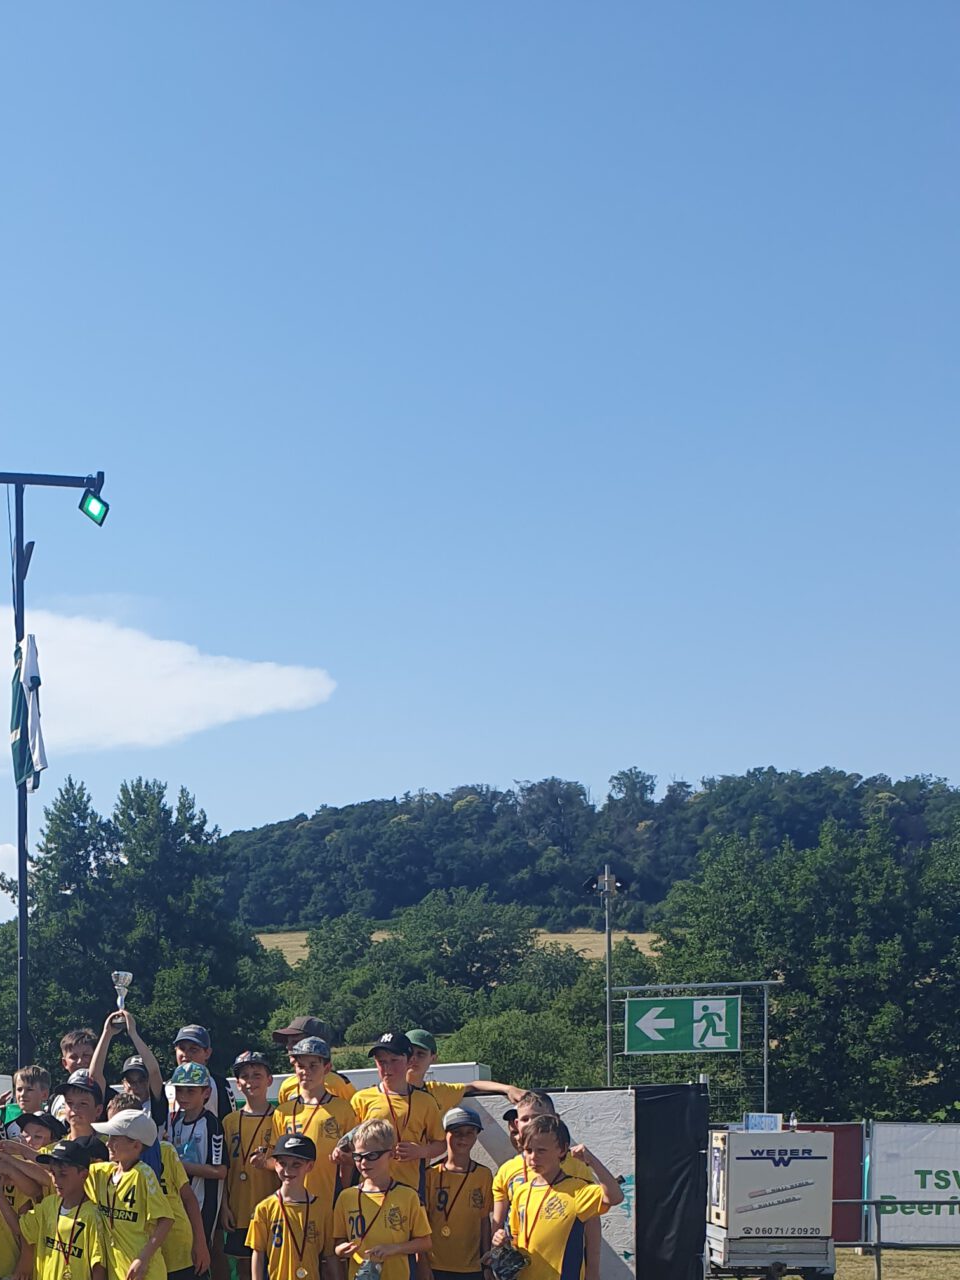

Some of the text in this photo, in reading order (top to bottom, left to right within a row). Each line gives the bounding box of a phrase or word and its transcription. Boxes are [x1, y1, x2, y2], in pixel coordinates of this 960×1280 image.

[123, 1185, 136, 1208] 4
[73, 1220, 86, 1244] 7
[349, 1212, 366, 1240] 20
